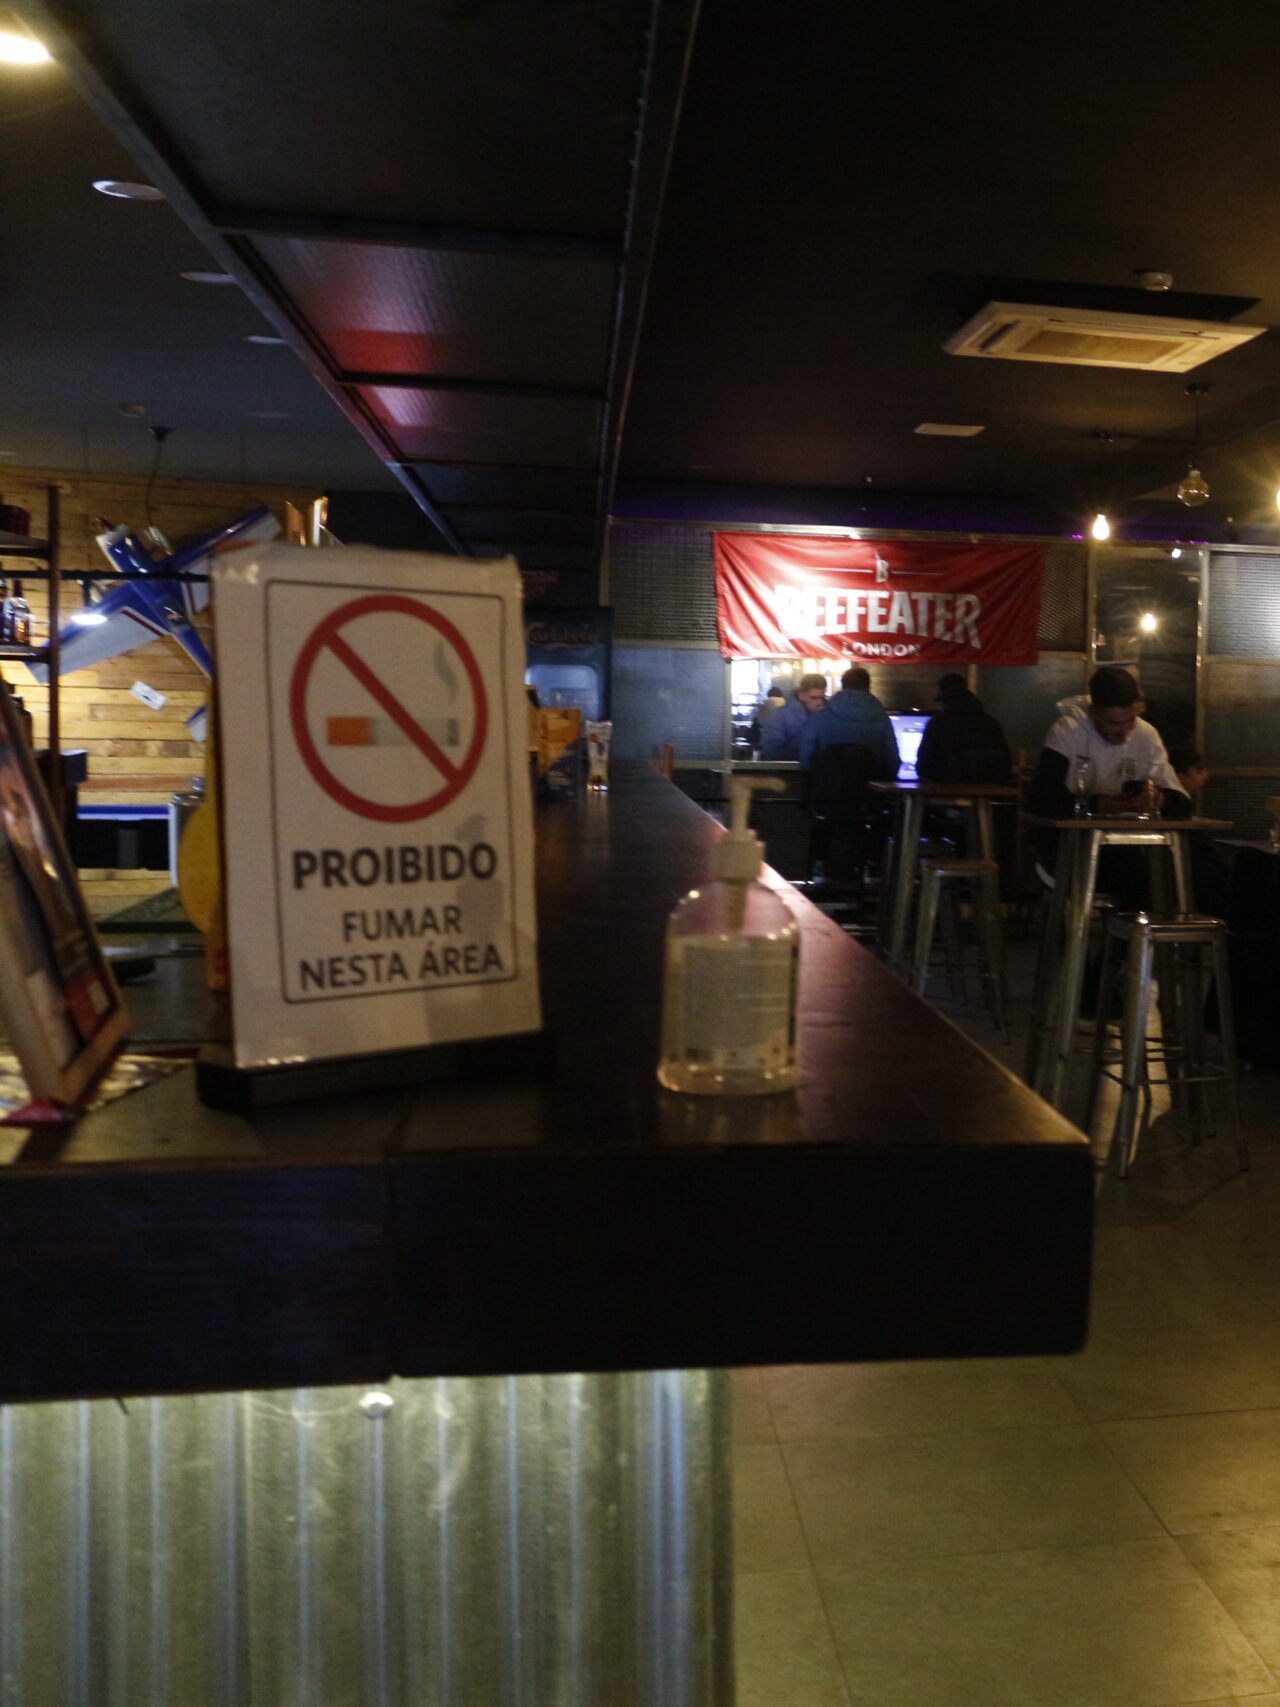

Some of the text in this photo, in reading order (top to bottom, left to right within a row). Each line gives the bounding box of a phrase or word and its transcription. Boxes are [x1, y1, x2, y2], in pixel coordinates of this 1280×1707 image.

[774, 584, 983, 650] BEEFEATER
[841, 641, 921, 657] LONDON
[293, 842, 497, 890] PROIBIDO
[342, 904, 463, 944] FUMAR
[300, 941, 504, 992] NESTA ÁREA
